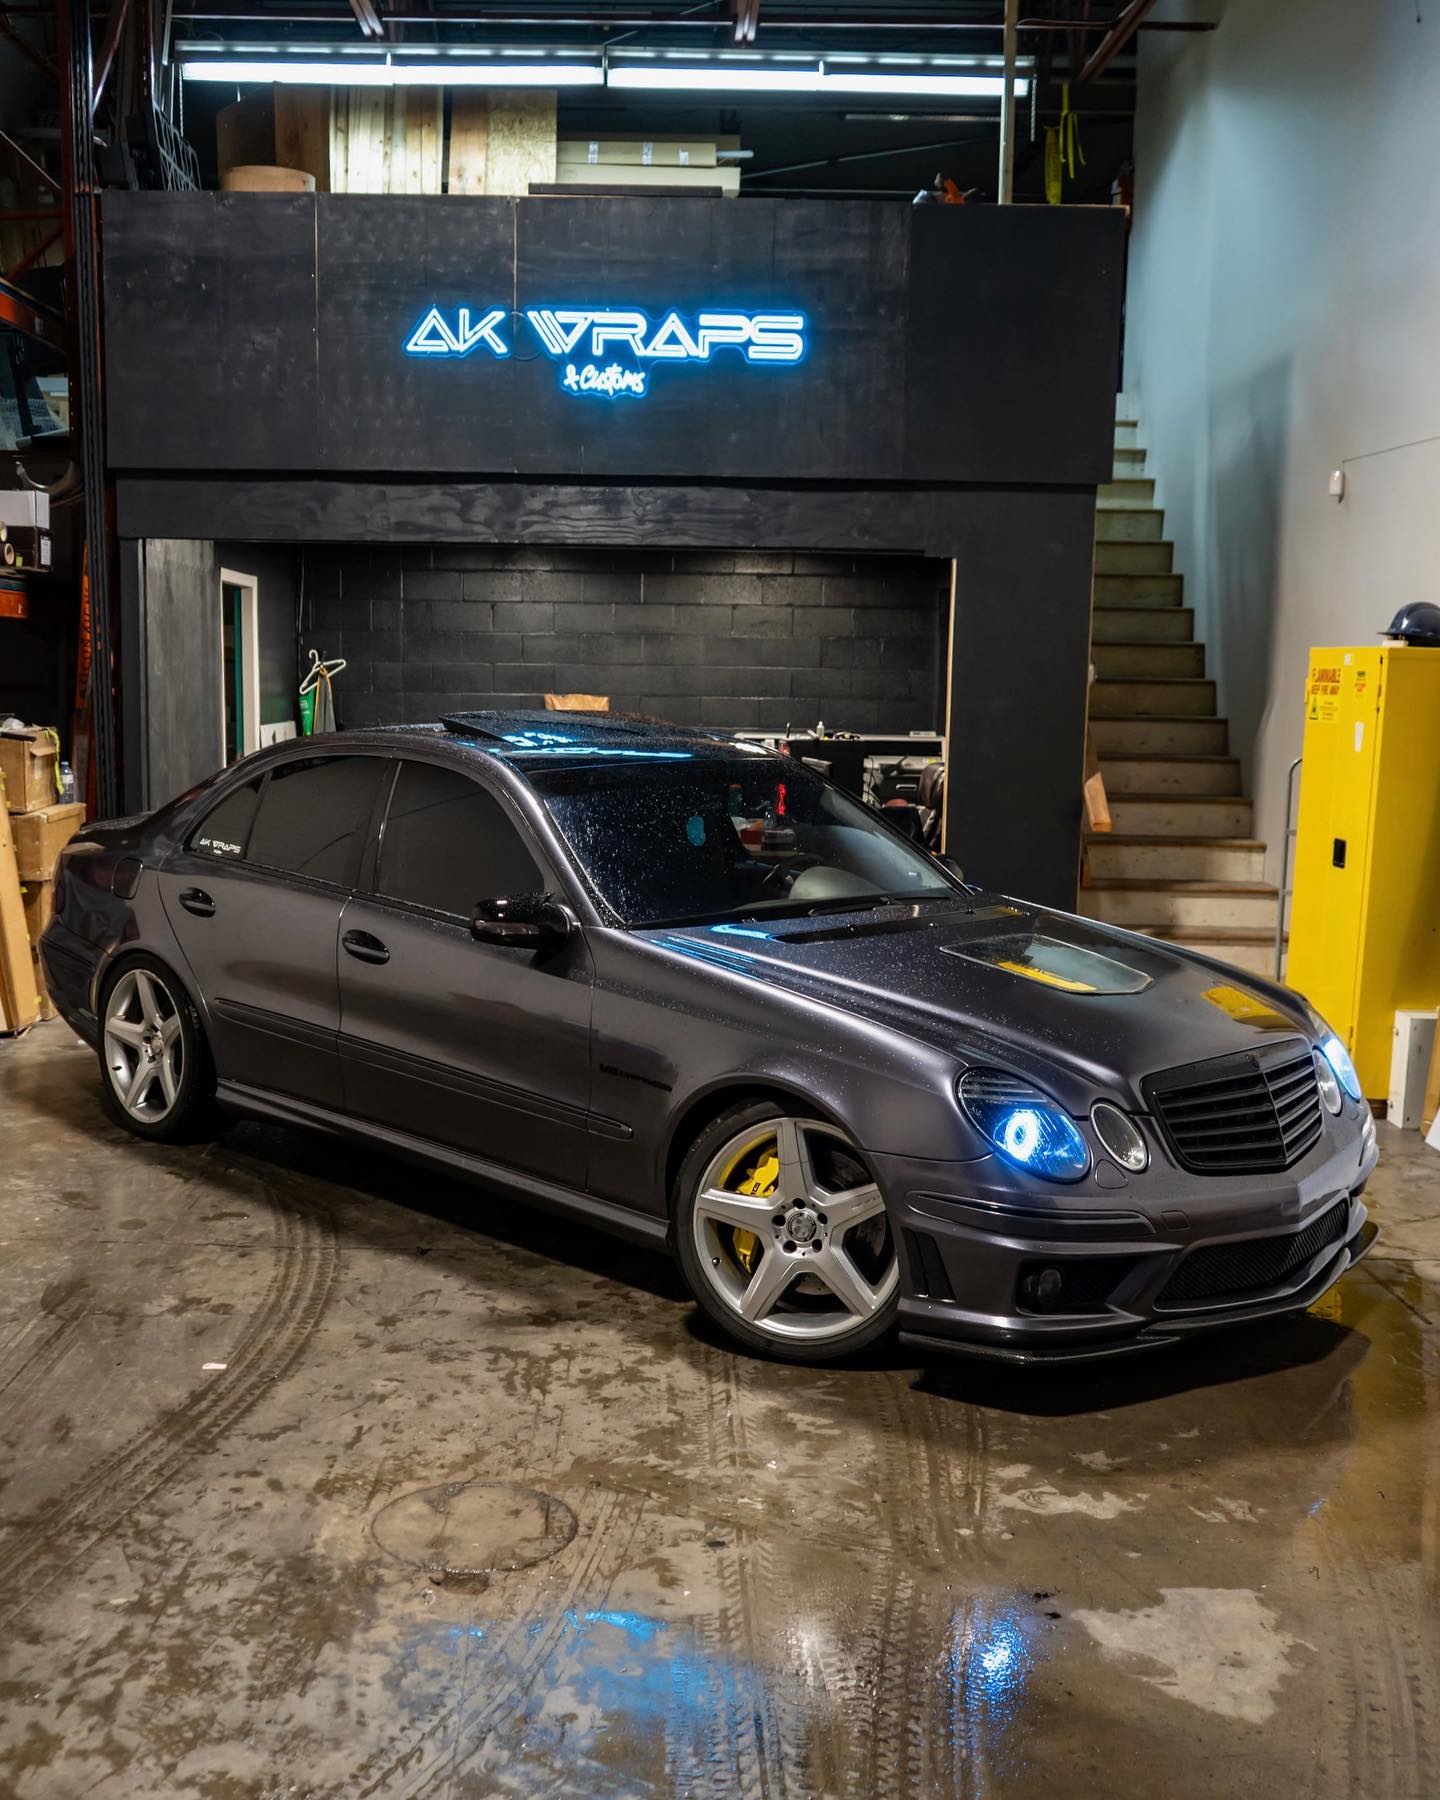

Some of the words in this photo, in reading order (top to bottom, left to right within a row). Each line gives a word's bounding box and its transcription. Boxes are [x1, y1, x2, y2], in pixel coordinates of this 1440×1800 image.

[406, 307, 508, 354] AK
[527, 309, 804, 360] WRAPS
[200, 838, 211, 846] AK
[212, 840, 241, 853] WRAPS
